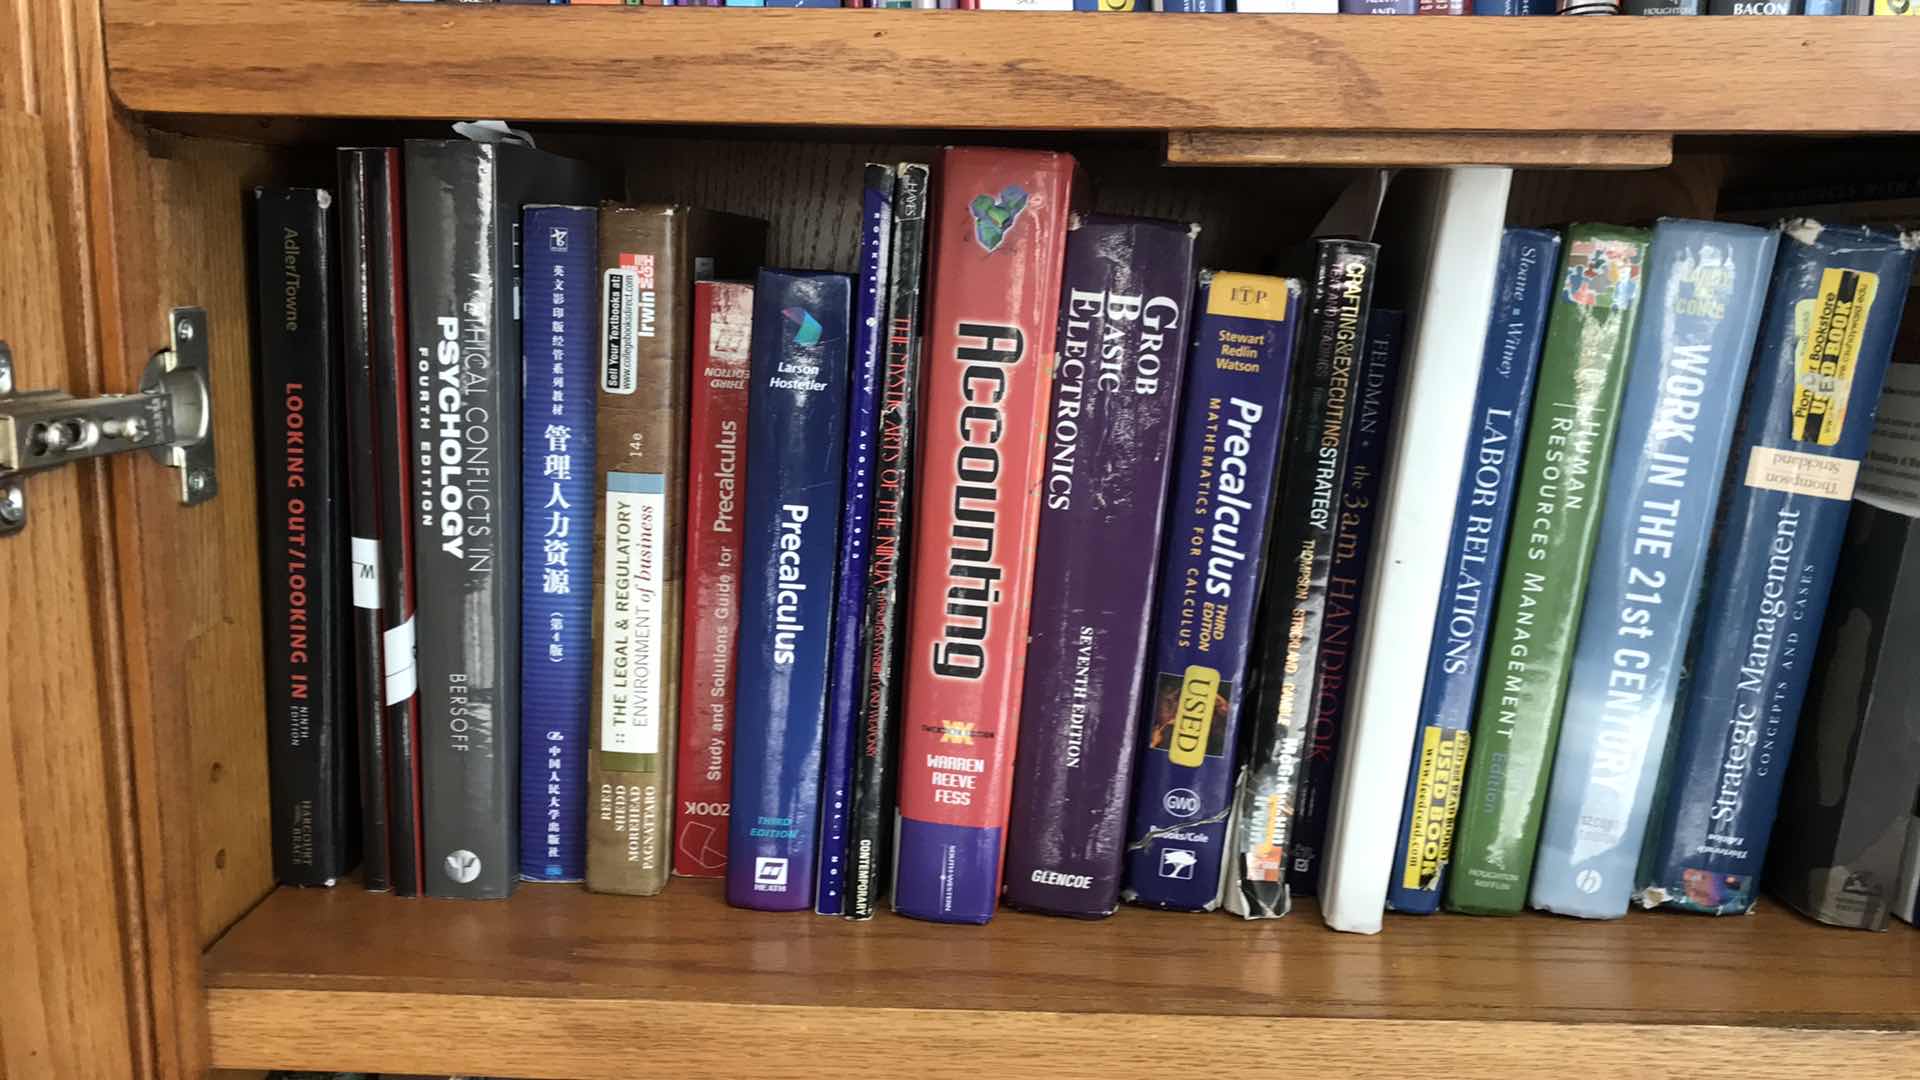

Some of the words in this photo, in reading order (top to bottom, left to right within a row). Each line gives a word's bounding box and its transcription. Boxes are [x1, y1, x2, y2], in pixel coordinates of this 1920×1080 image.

[1733, 3, 1790, 15] BACON
[903, 182, 918, 217] HAYES
[282, 226, 300, 331] Adler/Towne
[1512, 245, 1536, 307] Sloane
[609, 294, 621, 341] Textbooks
[622, 275, 633, 390] www.collegebooksdirect.com
[638, 291, 655, 337] Irwin
[889, 317, 913, 345] THE
[1097, 291, 1144, 394] BASIC
[1218, 329, 1265, 346] Stewart
[1809, 292, 1837, 361] Bookstore
[1826, 300, 1852, 356] BOOK
[609, 341, 620, 365] Your
[777, 361, 820, 375] Larson
[1135, 296, 1180, 396] GROB
[1215, 358, 1260, 373] Watson
[1220, 344, 1259, 359] Redlin
[1497, 322, 1525, 379] Witney
[419, 346, 431, 430] FOURTH
[607, 368, 619, 387] Sell
[709, 378, 745, 389] THIRD
[769, 377, 828, 391] Hostetler
[1048, 287, 1107, 512] ELECTRONICS
[1359, 338, 1391, 434] FELDMAN
[1655, 344, 1713, 445] WORK
[286, 383, 305, 489] LOOKING
[437, 316, 465, 560] PSYCHOLOGY
[630, 432, 644, 457] 14e
[856, 429, 869, 499] AUGUST
[881, 418, 904, 463] ARTS
[1195, 397, 1222, 516] MATHEMATICS
[1471, 406, 1513, 507] LABOR
[422, 441, 433, 526] EDITION
[464, 406, 491, 536] CONFLICTS
[713, 420, 737, 533] Precalculus
[880, 470, 900, 493] OF
[930, 320, 1027, 682] Accounting
[1205, 396, 1264, 599] Precalculus
[1352, 465, 1371, 489] the
[1527, 417, 1574, 561] RESOURCES
[1648, 452, 1690, 488] IN
[542, 424, 572, 596] 管理人力资源
[876, 499, 897, 531] THE
[1190, 526, 1205, 556] FOR
[1633, 499, 1681, 559] THE
[467, 545, 492, 573] IN
[615, 501, 632, 616] REGULATORY
[634, 504, 655, 583] business
[717, 545, 733, 568] for
[872, 535, 895, 586] NINJA
[1296, 539, 1317, 601] THOMPSON
[287, 500, 308, 664] OUT/LOOKING
[714, 574, 731, 619] Guide
[773, 504, 809, 666] Precalculus
[1178, 567, 1200, 648] CALCULUS
[1442, 515, 1494, 676] RELATIONS
[1617, 567, 1667, 640] 21st
[616, 618, 629, 630] &
[1198, 601, 1215, 652] EDITION
[1212, 603, 1229, 641] THIRD
[1285, 607, 1308, 673] STRICKLAND
[614, 635, 628, 688] LEGAL
[632, 607, 651, 728] ENVIRONMENT
[711, 625, 730, 698] Solutions
[1073, 625, 1094, 700] SEVENTH
[1308, 577, 1357, 762] HANDBOOK
[1497, 571, 1547, 740] MANAGEMENT
[1711, 703, 1758, 823] Strategic
[1735, 507, 1801, 694] Management
[1756, 681, 1788, 777] CONCEPTS
[1781, 632, 1800, 670] AND
[1793, 564, 1816, 620] CASES
[290, 674, 309, 700] IN
[448, 673, 469, 753] BERSOFF
[613, 694, 627, 727] THE
[711, 703, 725, 733] and
[1177, 677, 1211, 753] USED
[1066, 703, 1087, 769] EDITION
[1590, 648, 1651, 794] CENTURY
[707, 739, 726, 782] Study
[927, 754, 985, 773] WARREN
[932, 772, 977, 790] REEVE
[1434, 739, 1454, 800] USED
[547, 745, 562, 858] 中国人民大学出版社
[600, 784, 612, 821] REED
[615, 784, 626, 833] SHEDD
[627, 785, 641, 863] MOREHEAD
[757, 815, 794, 828] THIRD
[935, 789, 972, 806] FESS
[1409, 748, 1434, 869] www.feedread.com
[750, 827, 799, 839] EDITION
[856, 838, 871, 917] CONTEMPORARY
[1031, 869, 1095, 889] GLENCOE
